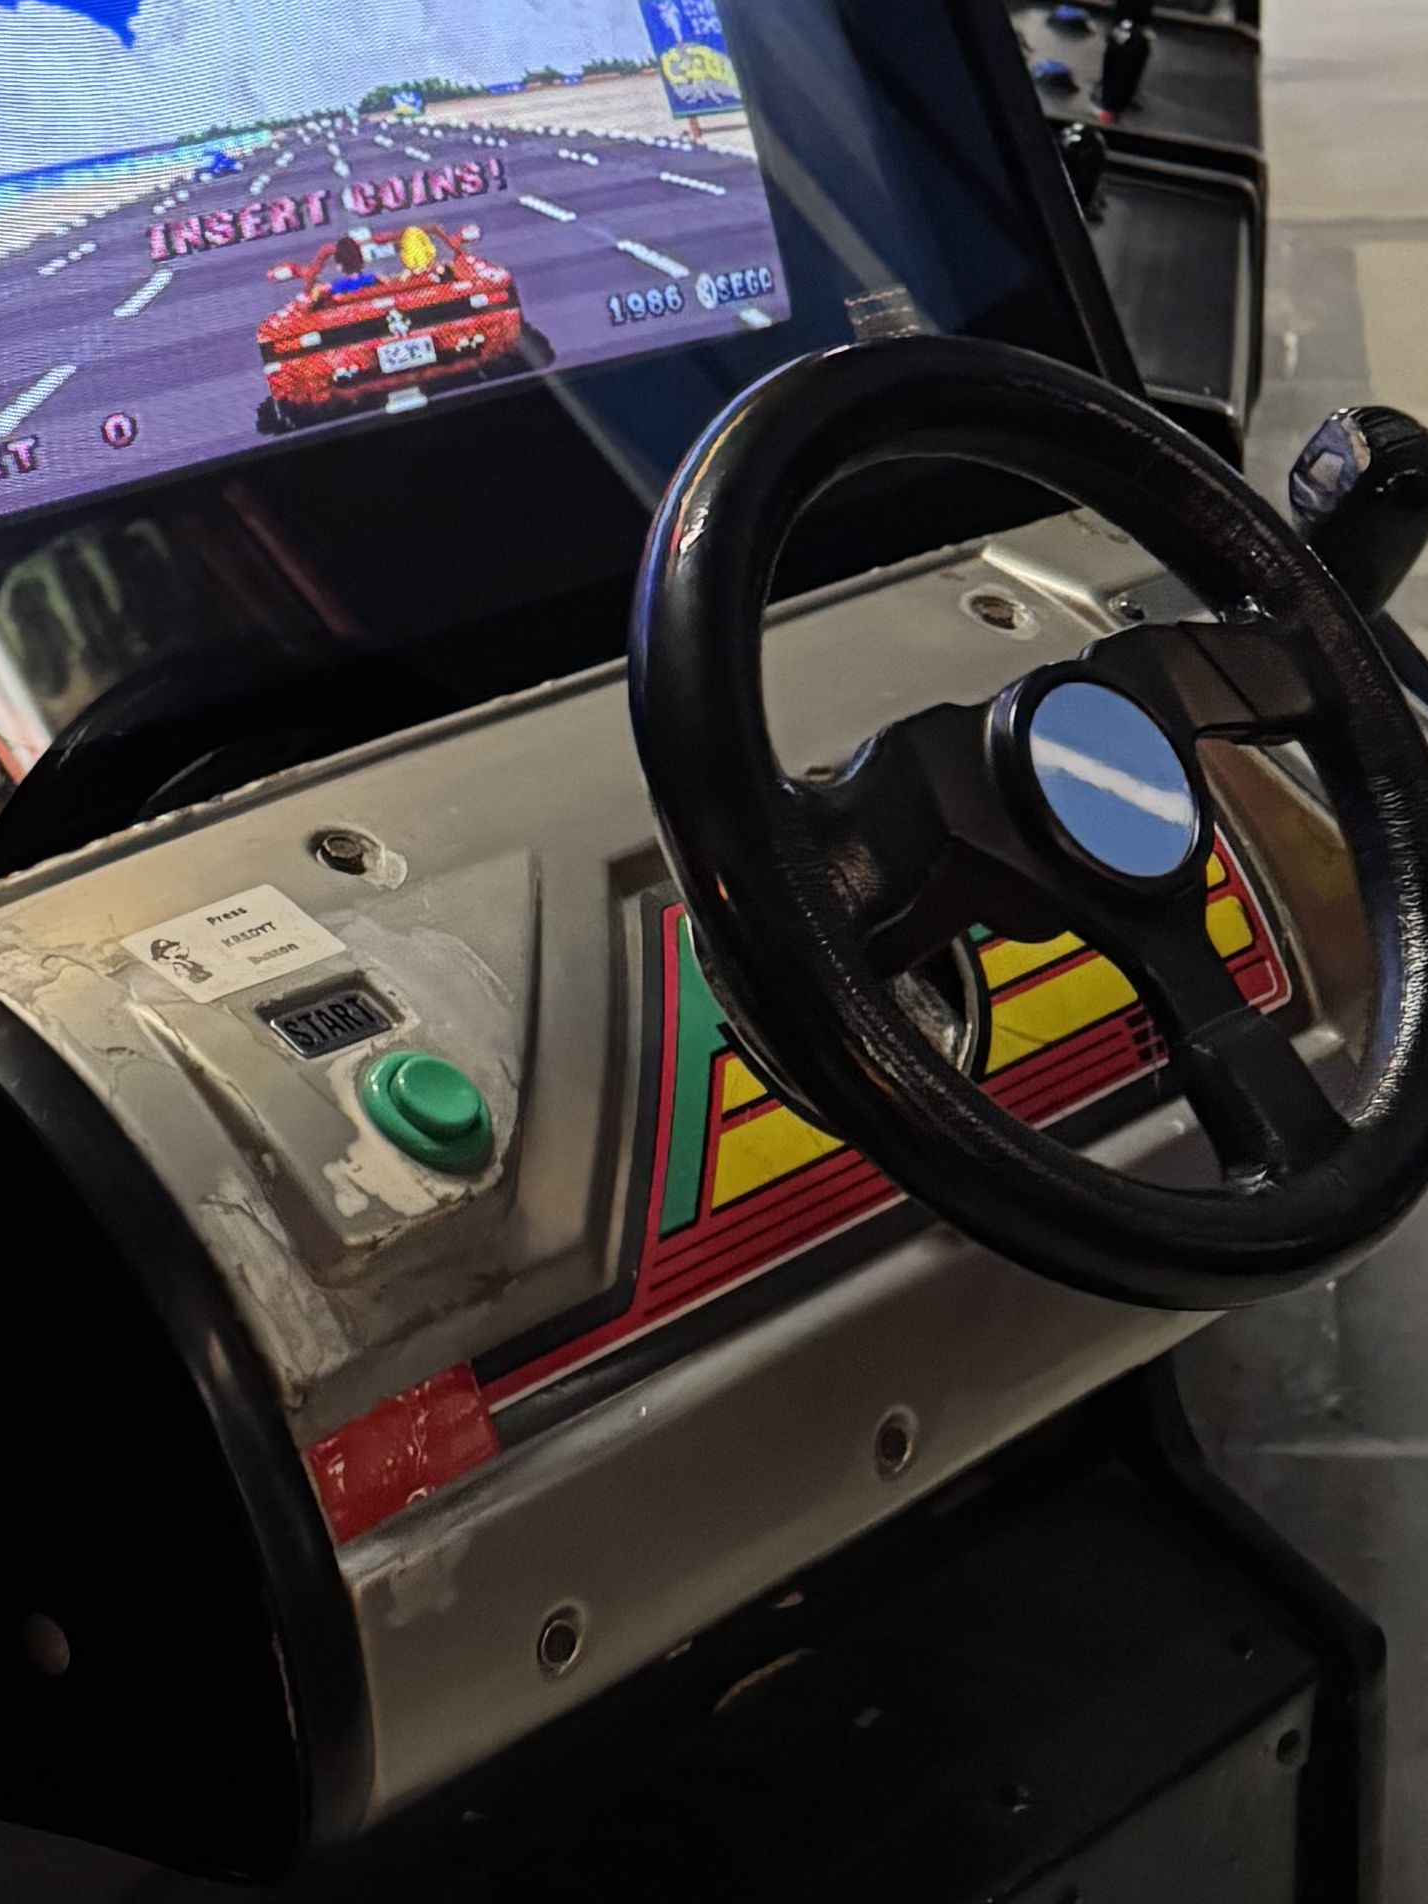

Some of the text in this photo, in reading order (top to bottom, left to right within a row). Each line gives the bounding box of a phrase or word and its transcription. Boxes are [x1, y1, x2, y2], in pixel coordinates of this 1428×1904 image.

[148, 158, 508, 259] INSERT COINS!
[608, 283, 684, 325] 1986
[101, 411, 138, 448] 0
[206, 907, 248, 926] Press
[284, 995, 377, 1046] START
